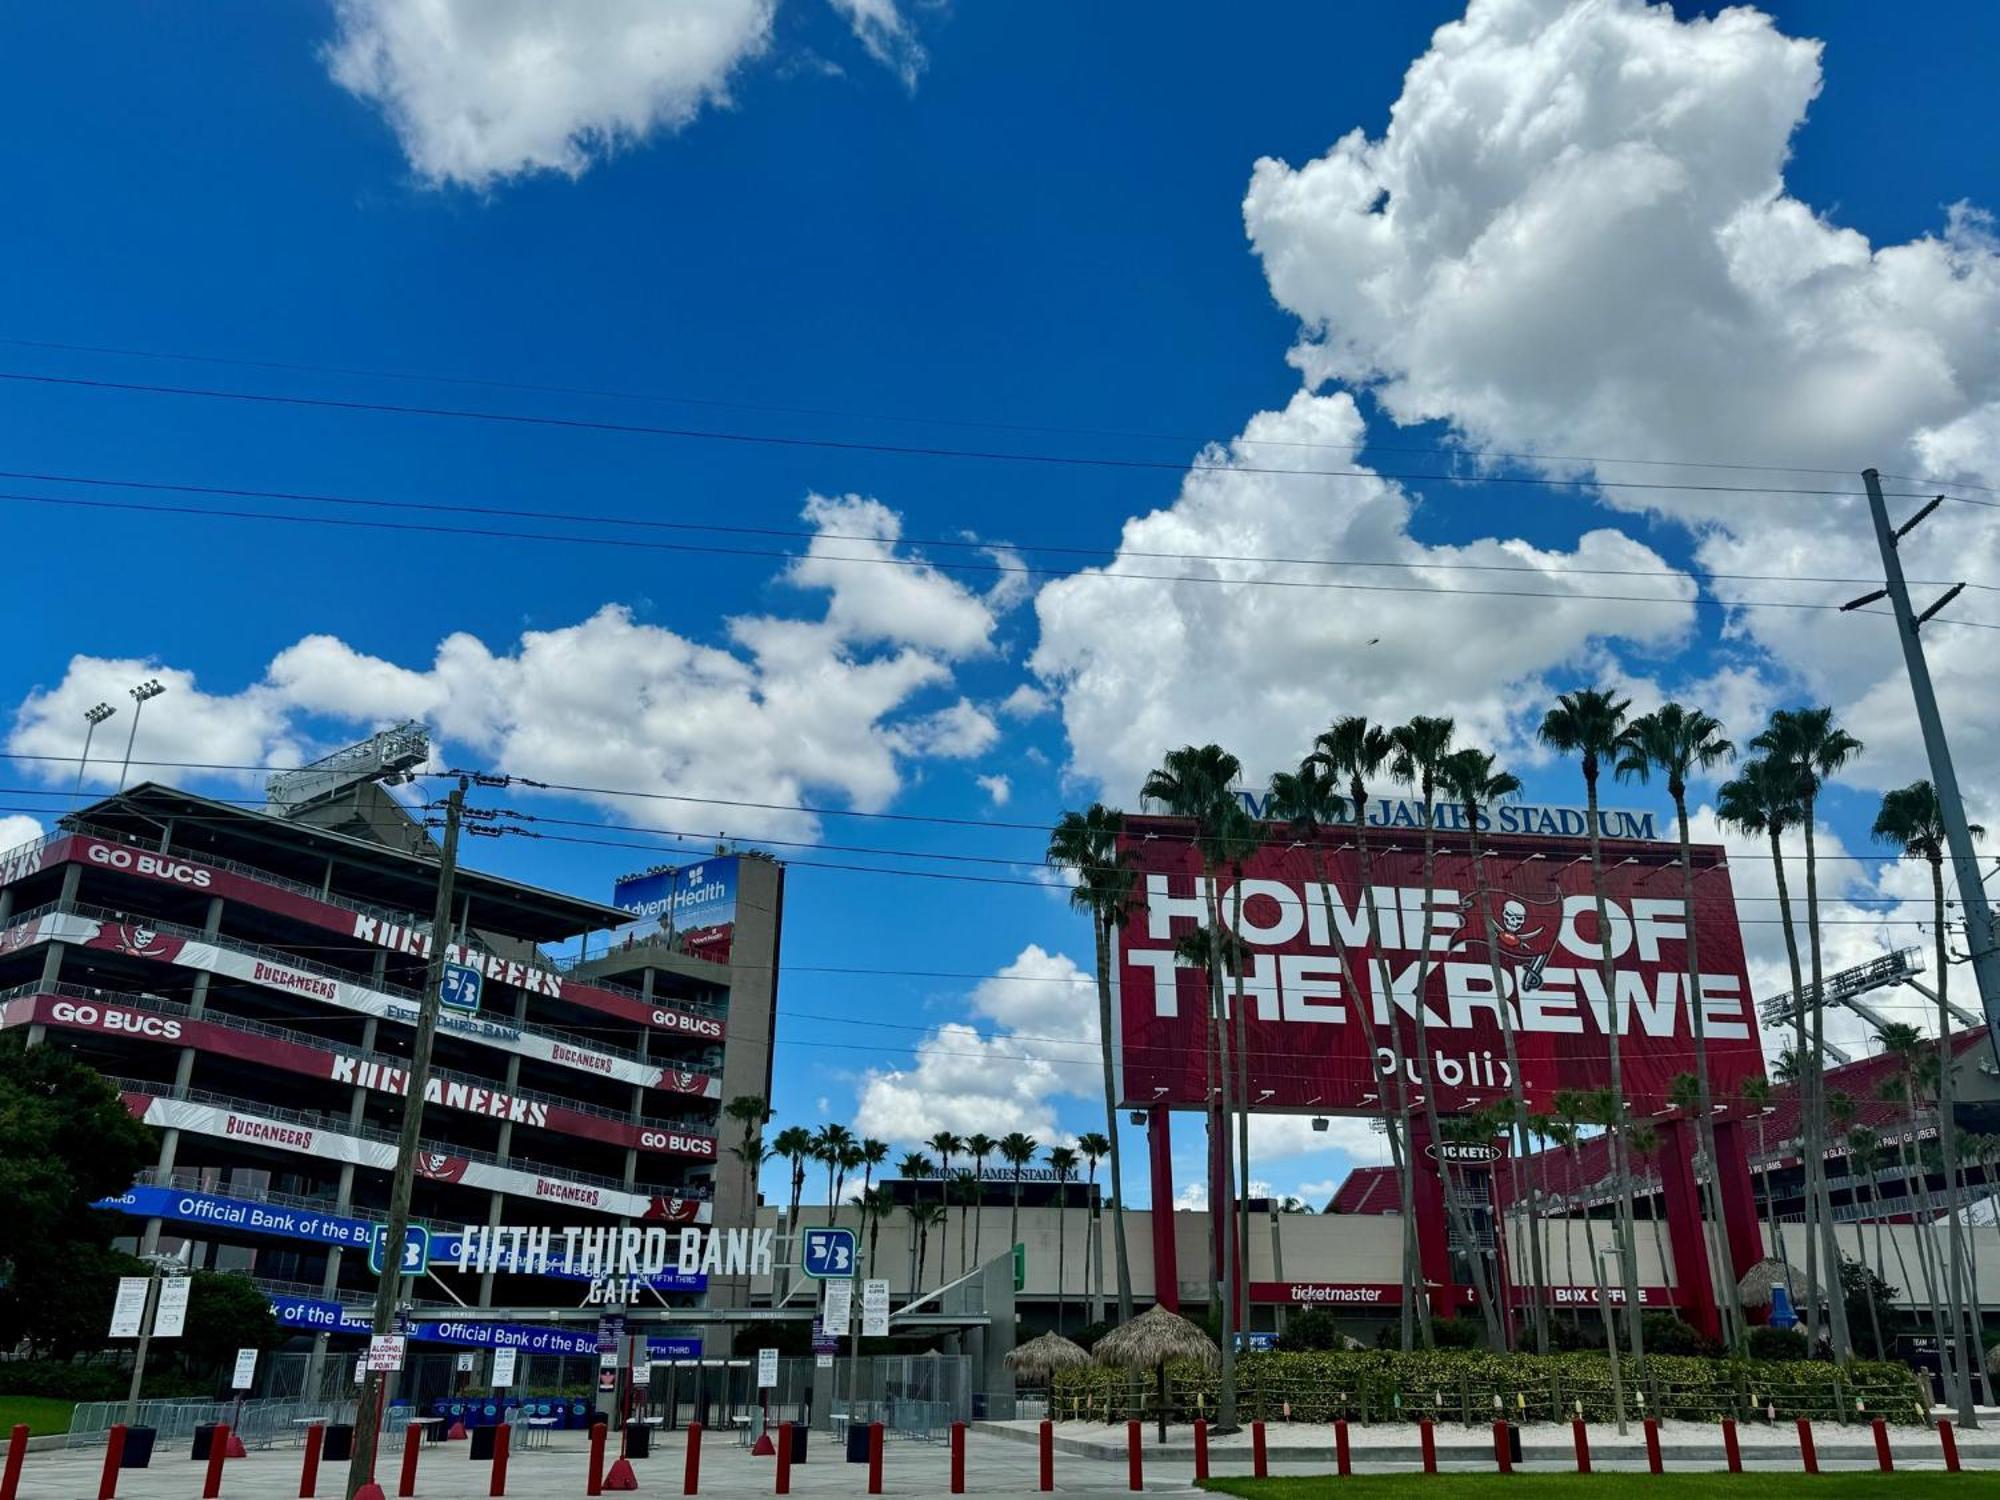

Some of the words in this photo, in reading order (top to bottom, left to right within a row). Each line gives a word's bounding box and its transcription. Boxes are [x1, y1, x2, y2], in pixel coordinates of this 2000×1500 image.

[1370, 799, 1491, 832] JAMES
[88, 844, 131, 868] GO
[136, 856, 211, 888] BUCS
[1147, 874, 1467, 954] HOME
[1557, 894, 1690, 962] OF
[254, 961, 337, 999] BUCCANEERS
[1128, 949, 1347, 1024] THE
[1367, 957, 1751, 1040] KREWE
[52, 1003, 98, 1025] GO
[103, 1013, 181, 1040] BUCS
[386, 1004, 420, 1022] FIFT
[483, 1023, 522, 1041] BANK
[652, 1010, 677, 1027] GO
[679, 1016, 720, 1037] BUCS
[552, 1043, 613, 1074] BUCCANEERS
[225, 1115, 313, 1149] BUCCANEERS
[641, 1131, 666, 1148] GO
[669, 1135, 712, 1154] BUCS
[1432, 1145, 1496, 1159] ICKETS
[1019, 1169, 1078, 1182] STADIM
[536, 1178, 599, 1206] BUCCANEERS
[178, 1198, 246, 1224] Official
[251, 1210, 293, 1231] Bank
[300, 1219, 318, 1235] of
[322, 1221, 348, 1240] the
[458, 1225, 550, 1274] FIFTH
[562, 1226, 667, 1275] THIRD
[677, 1227, 774, 1276] BANK
[810, 1234, 850, 1270] 5/3
[589, 1279, 641, 1304] GATE
[1291, 1285, 1383, 1302] ticketmaster
[1556, 1289, 1588, 1302] BOX
[1592, 1290, 1648, 1303] OFFIE
[284, 1304, 304, 1320] of
[307, 1306, 336, 1324] the
[439, 1322, 492, 1342] Official
[495, 1328, 529, 1347] Bank
[533, 1333, 549, 1348] of
[551, 1335, 574, 1351] the
[576, 1337, 599, 1354] Buc
